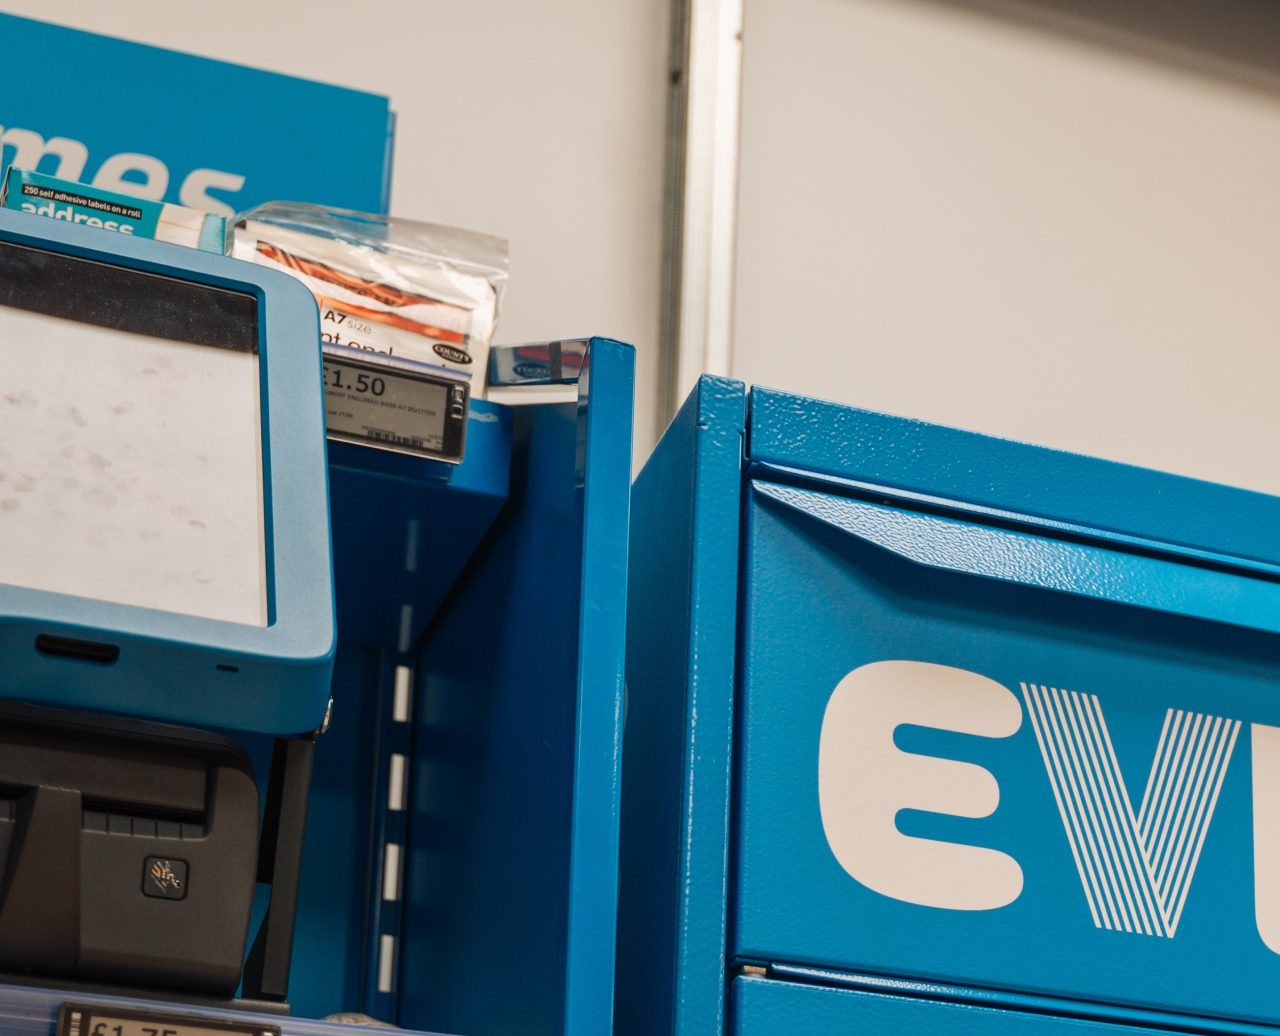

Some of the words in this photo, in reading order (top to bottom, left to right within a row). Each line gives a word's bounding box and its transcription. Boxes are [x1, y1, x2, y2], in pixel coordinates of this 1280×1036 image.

[24, 186, 38, 195] 250
[39, 190, 55, 199] self
[54, 192, 87, 206] adhesive
[88, 199, 111, 212] labels
[127, 208, 141, 218] roll
[324, 309, 346, 325] A7
[347, 318, 373, 334] size
